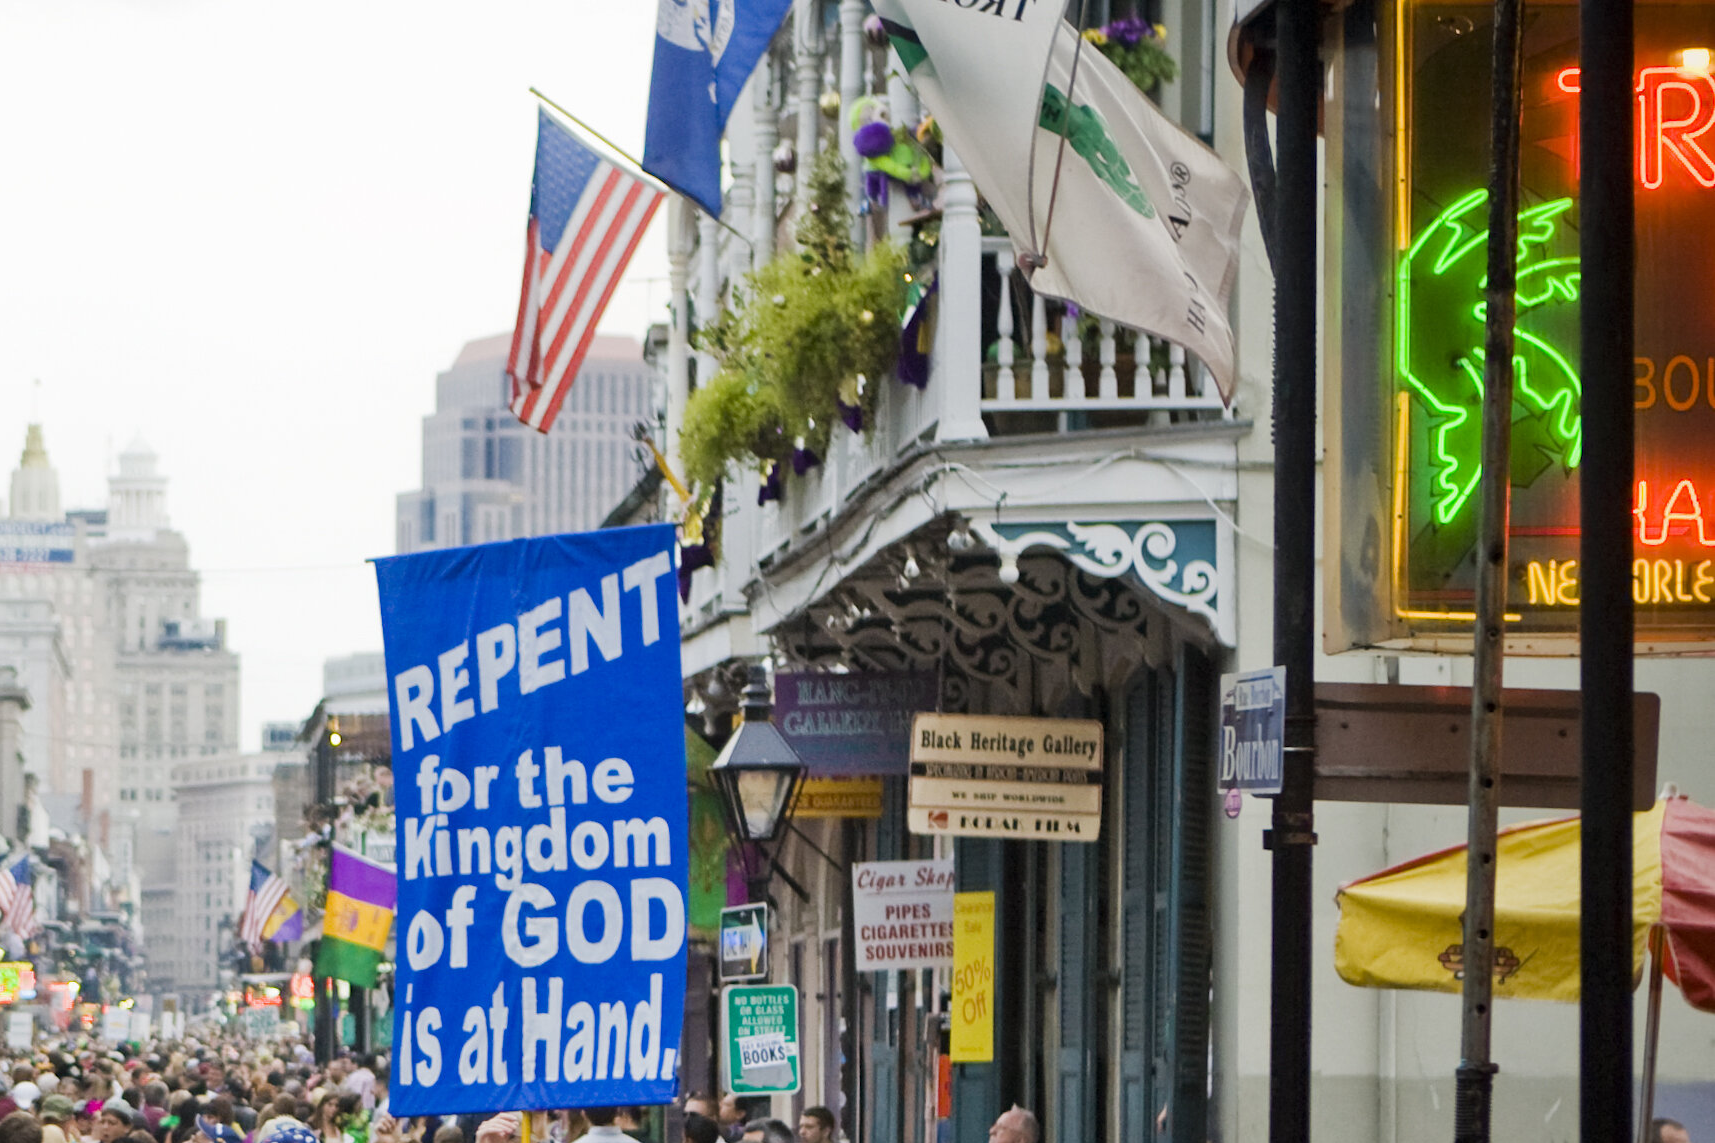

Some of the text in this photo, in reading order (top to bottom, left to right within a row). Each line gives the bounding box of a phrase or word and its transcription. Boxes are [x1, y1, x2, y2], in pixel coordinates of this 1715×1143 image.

[395, 550, 672, 752] REPENT
[783, 710, 884, 737] GALLERY
[921, 730, 1098, 762] Black Heritage Gallery
[1221, 723, 1279, 781] Bourbon
[417, 745, 635, 815] for the
[1003, 793, 1066, 804] WORLDWIDE
[960, 815, 1081, 834] KODAK FILM
[403, 806, 672, 893] Kingdom
[857, 867, 955, 896] Cigar Shop
[407, 876, 686, 972] of GOD
[885, 903, 931, 920] PIPES
[861, 921, 954, 940] CIGARETTES
[865, 941, 954, 961] SOUVENIRS
[955, 958, 992, 996] 50%
[734, 994, 789, 1006] NO BOTTLES
[739, 1005, 785, 1016] OR GLASS
[962, 990, 987, 1026] Off
[398, 972, 676, 1087] is at Hand.
[738, 1026, 750, 1036] ON
[742, 1015, 783, 1026] ALLOWED
[743, 1045, 786, 1066] BOOKS
